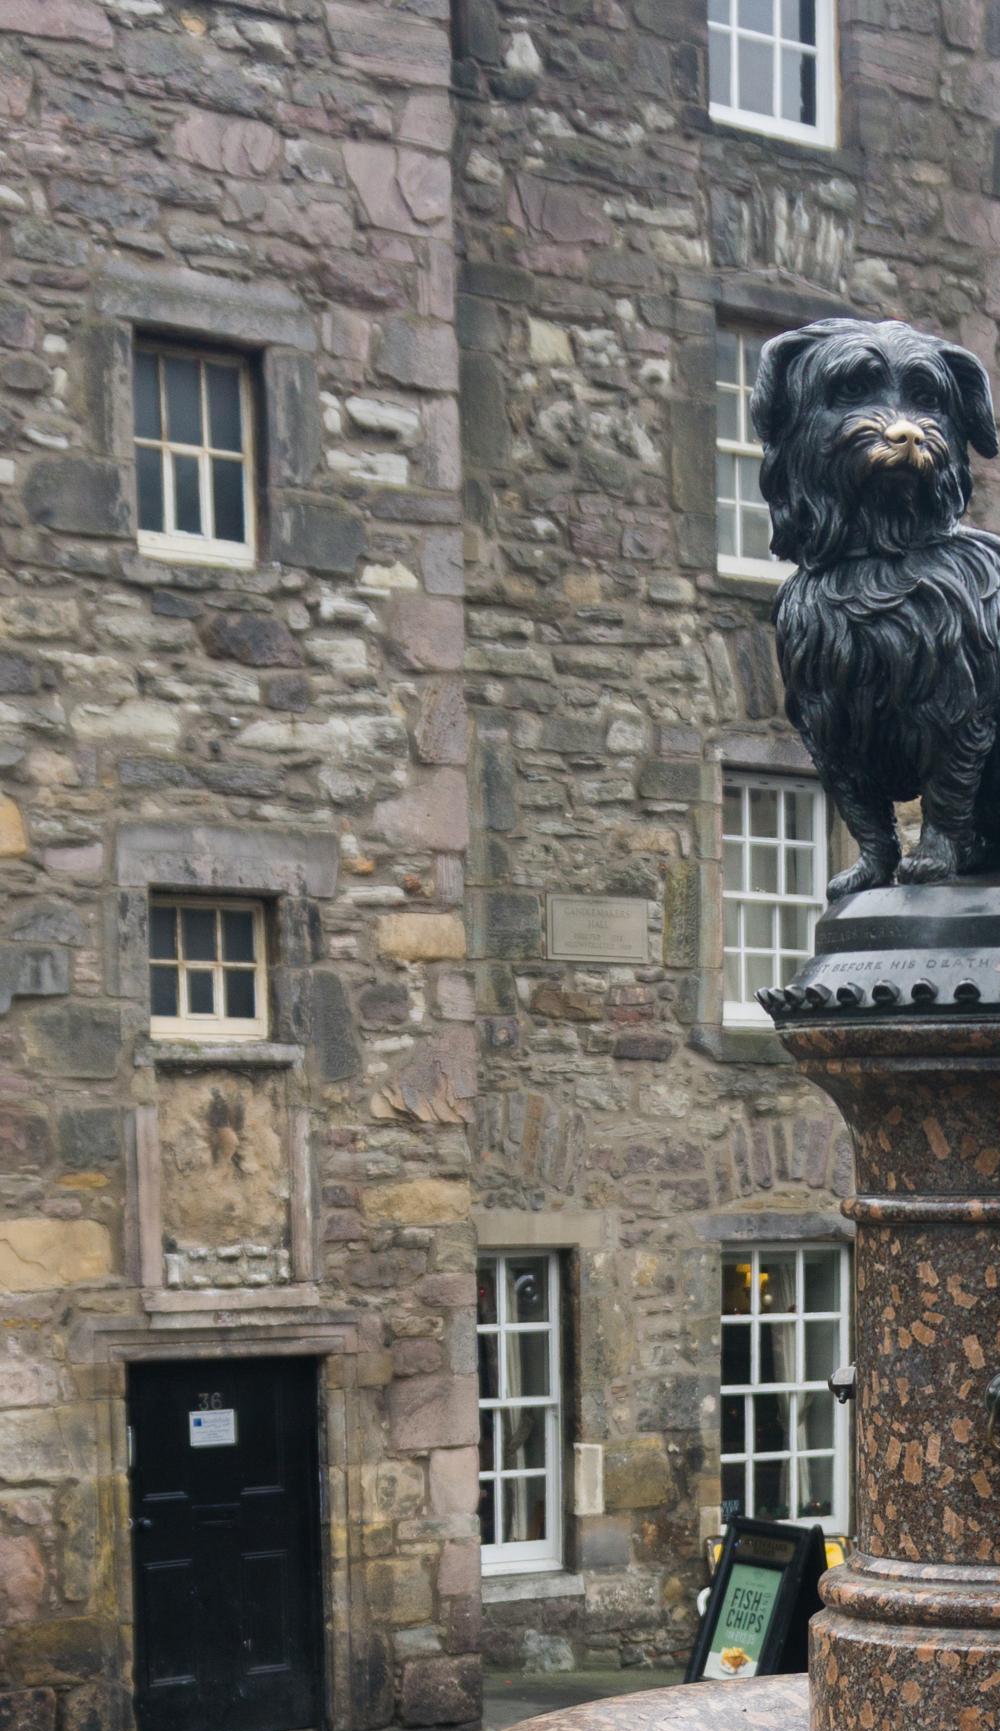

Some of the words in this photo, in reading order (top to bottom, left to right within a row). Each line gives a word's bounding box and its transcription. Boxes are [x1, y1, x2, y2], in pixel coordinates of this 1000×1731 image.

[830, 960, 883, 973] BEFORE
[890, 957, 917, 971] HIS
[926, 956, 990, 970] DEATH
[198, 1392, 222, 1411] 36
[731, 1587, 763, 1611] FISH
[726, 1608, 764, 1633] CHIPS
